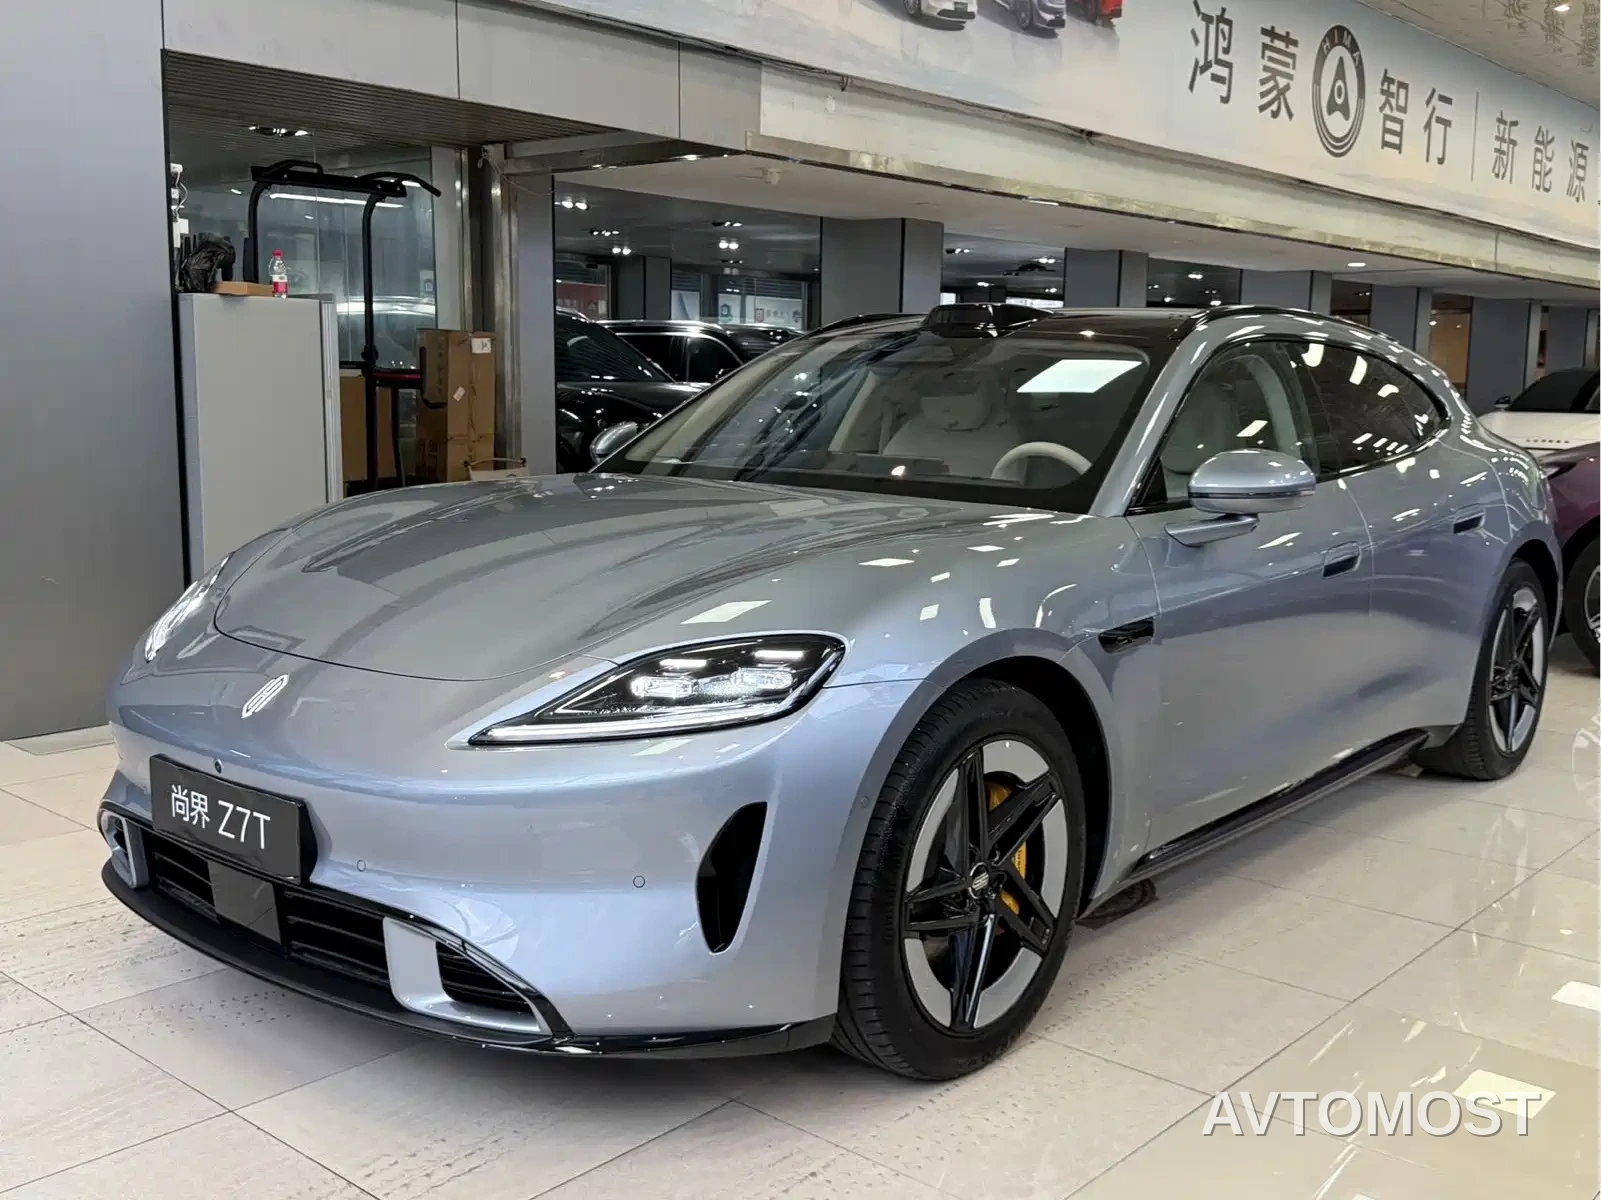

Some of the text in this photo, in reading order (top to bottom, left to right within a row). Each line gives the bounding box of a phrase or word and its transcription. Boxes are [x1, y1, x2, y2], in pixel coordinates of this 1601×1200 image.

[1321, 28, 1361, 67] HIMA
[1187, 0, 1589, 204] 鸿蒙 智行 新能源
[171, 784, 270, 849] 尚界 Z7T
